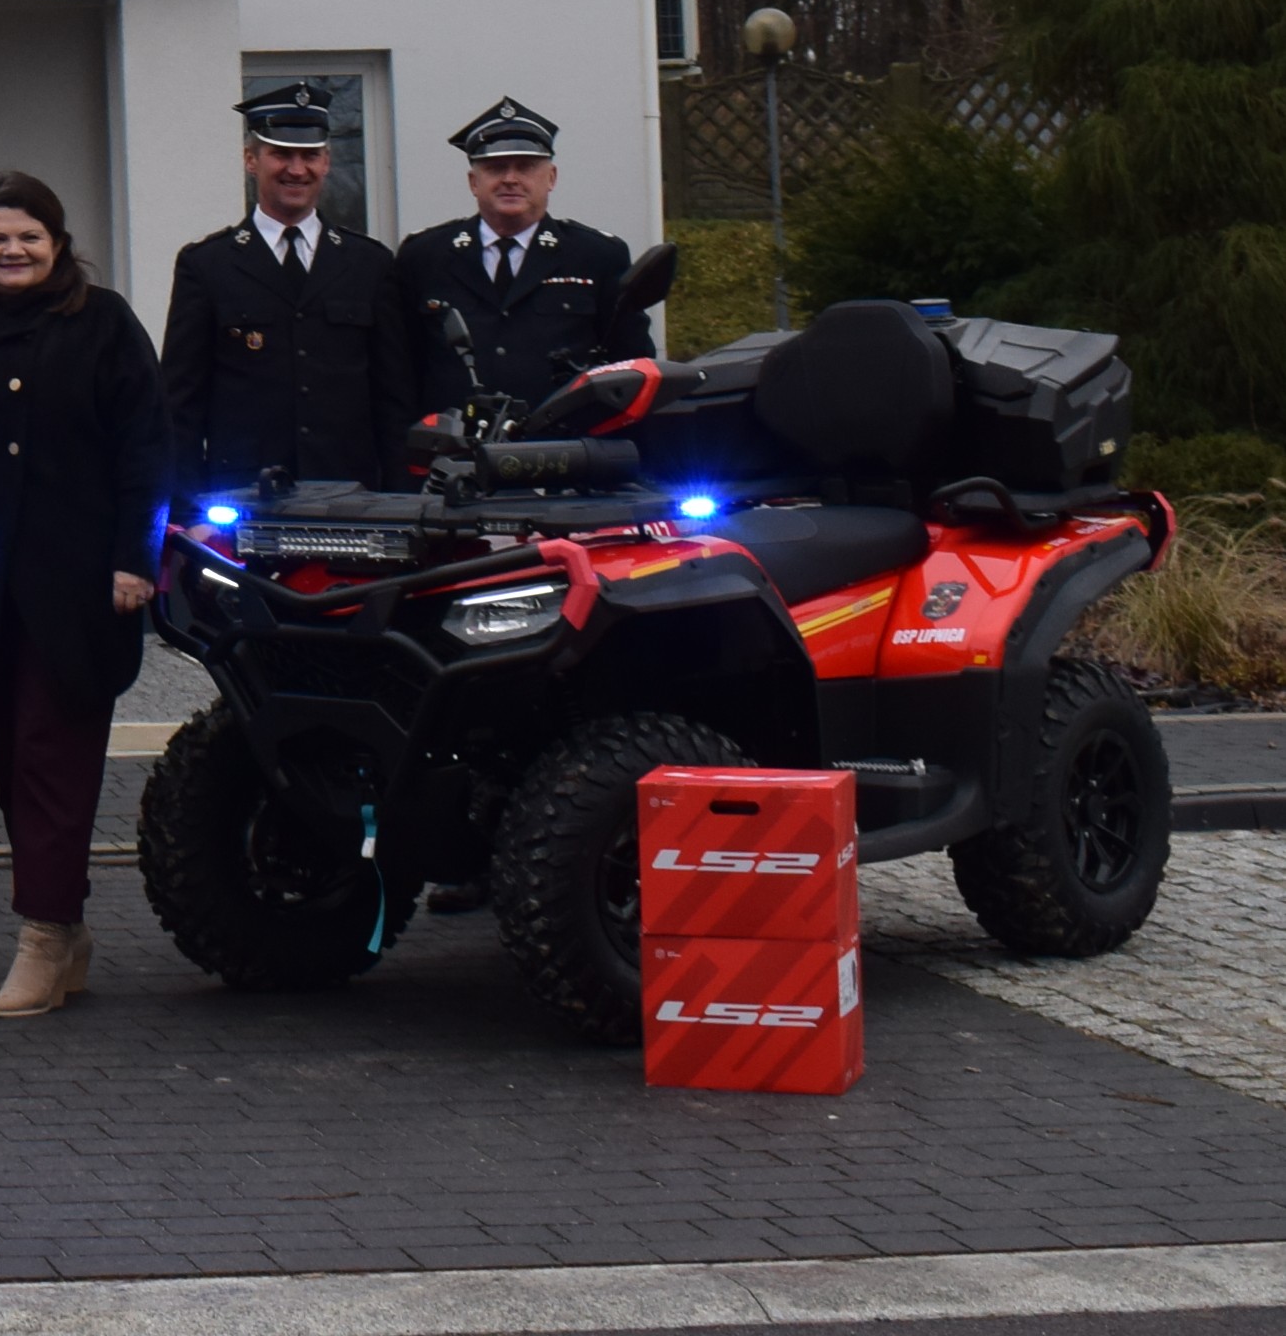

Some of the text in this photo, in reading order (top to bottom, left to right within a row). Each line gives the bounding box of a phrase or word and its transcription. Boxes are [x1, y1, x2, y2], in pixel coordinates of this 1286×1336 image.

[892, 630, 917, 645] OSP
[652, 849, 820, 875] LS2
[655, 1000, 824, 1028] LS2
